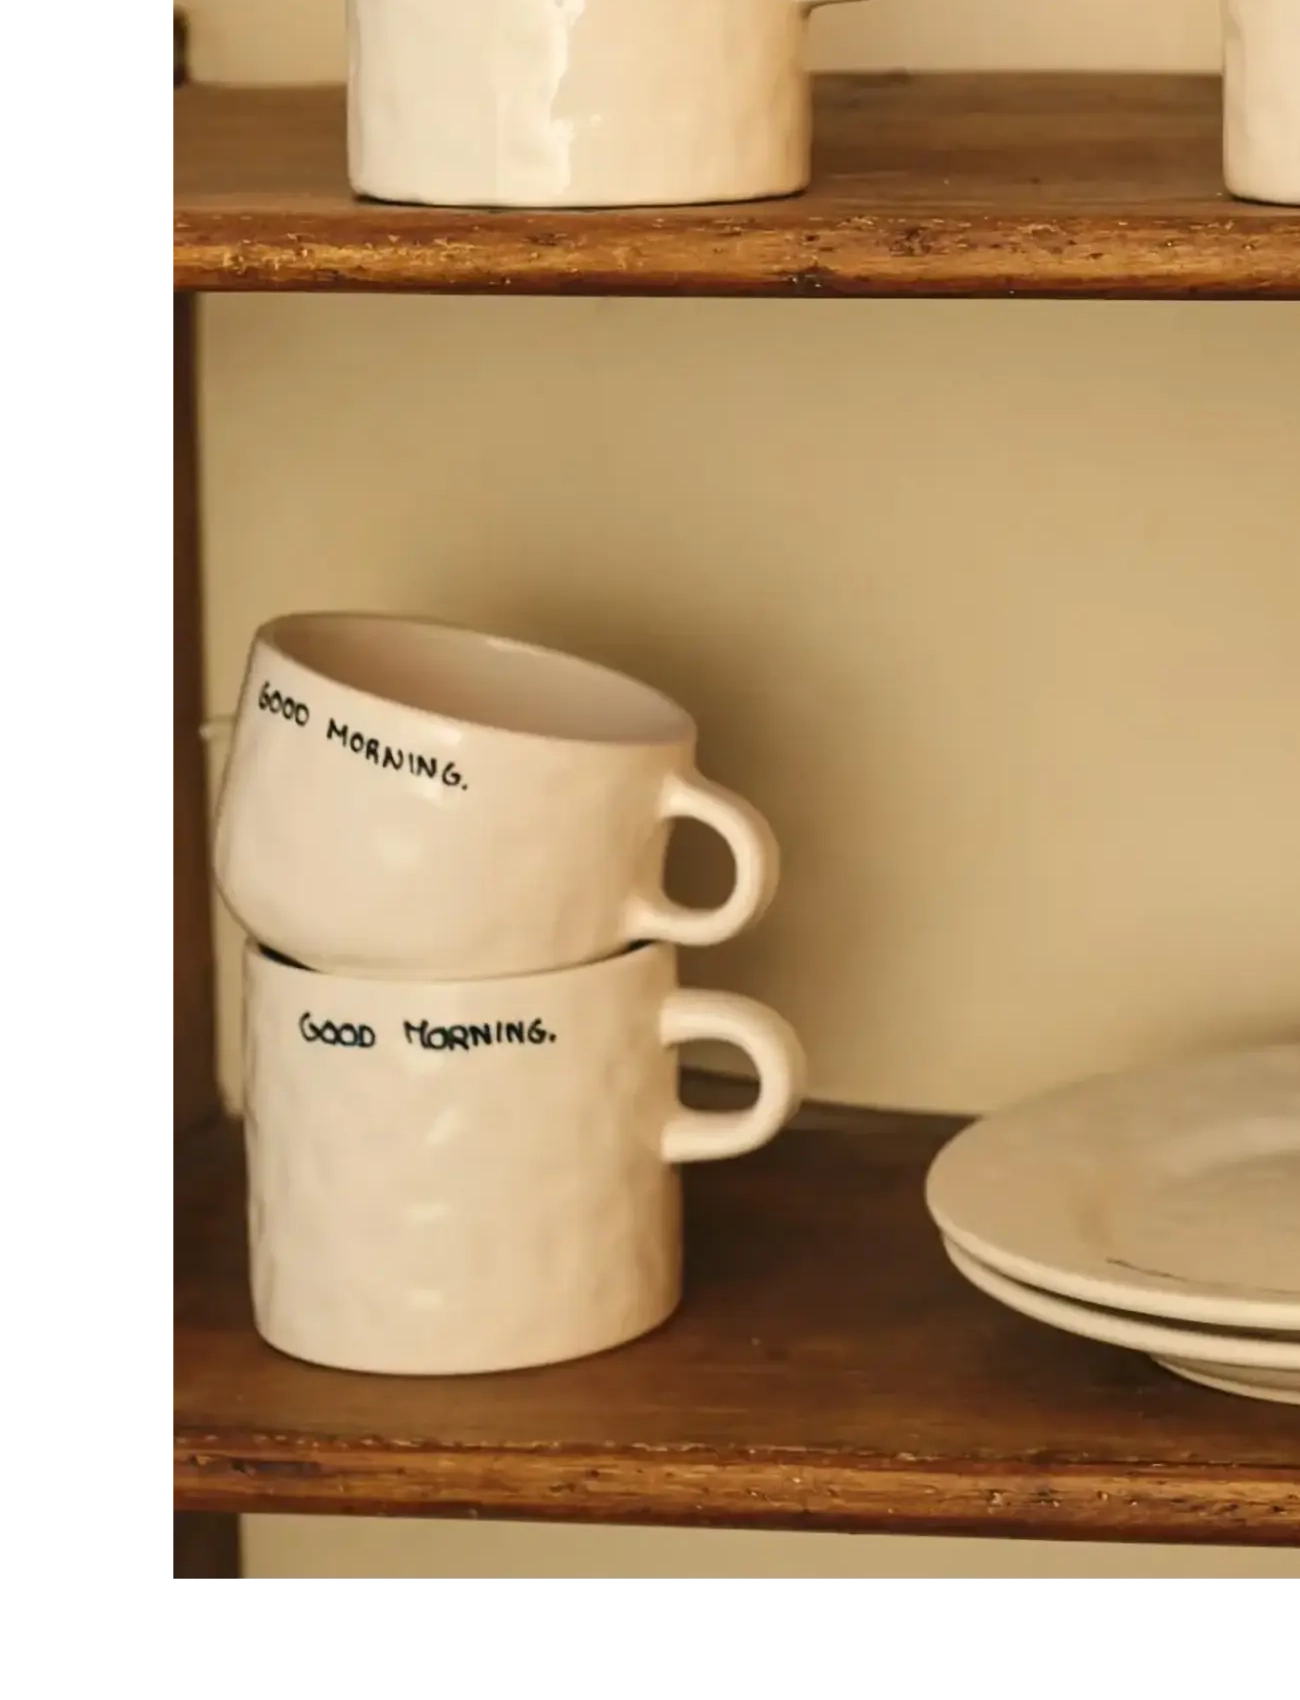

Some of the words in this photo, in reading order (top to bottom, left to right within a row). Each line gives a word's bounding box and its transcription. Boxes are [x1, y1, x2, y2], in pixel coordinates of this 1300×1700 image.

[258, 682, 310, 727] GOOD
[325, 718, 469, 791] MORNING.
[298, 1011, 377, 1049] GOOD
[402, 1017, 558, 1053] MORNING.
